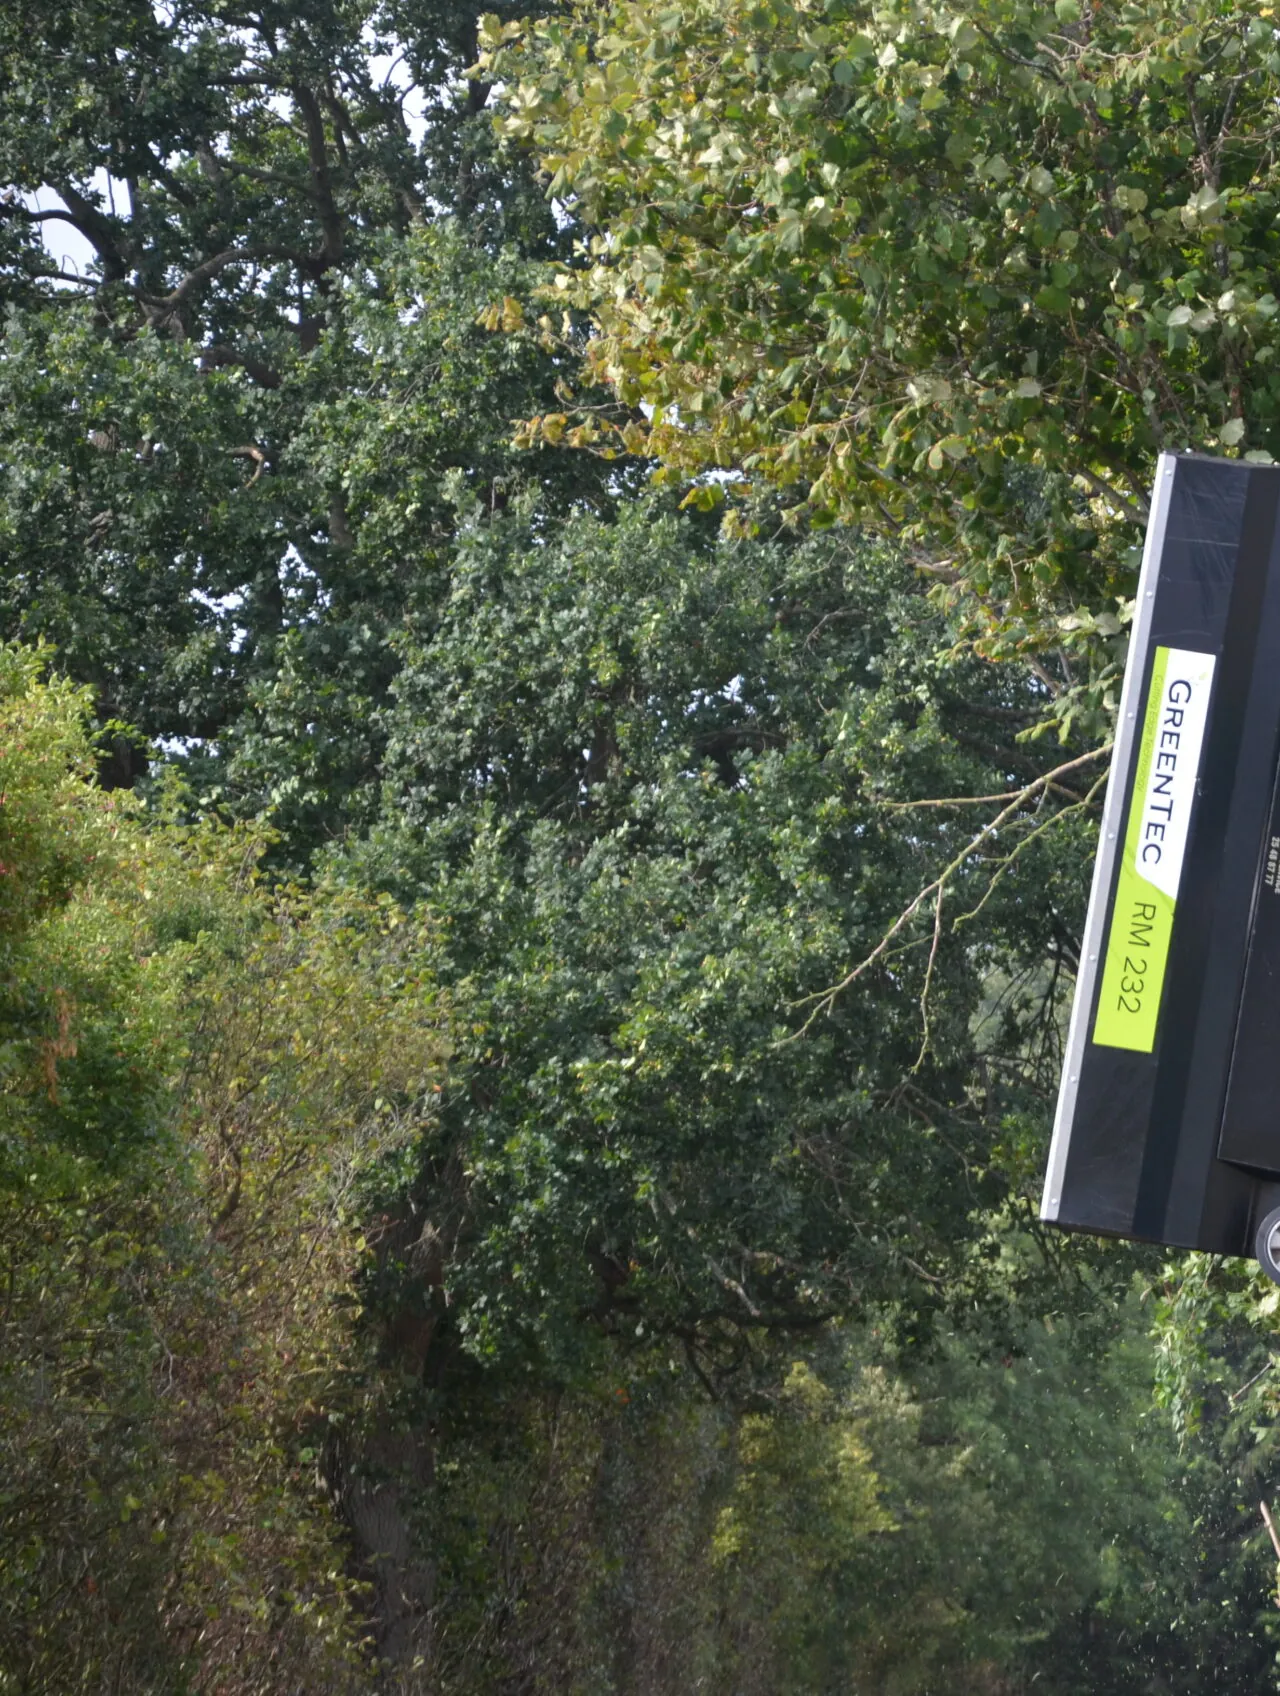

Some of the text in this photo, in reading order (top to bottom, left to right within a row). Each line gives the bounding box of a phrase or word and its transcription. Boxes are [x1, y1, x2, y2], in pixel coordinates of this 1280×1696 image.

[1137, 737, 1154, 793] Technology
[1271, 836, 1280, 848] 25
[1264, 874, 1274, 886] 77
[1117, 901, 1157, 1014] RM 232
